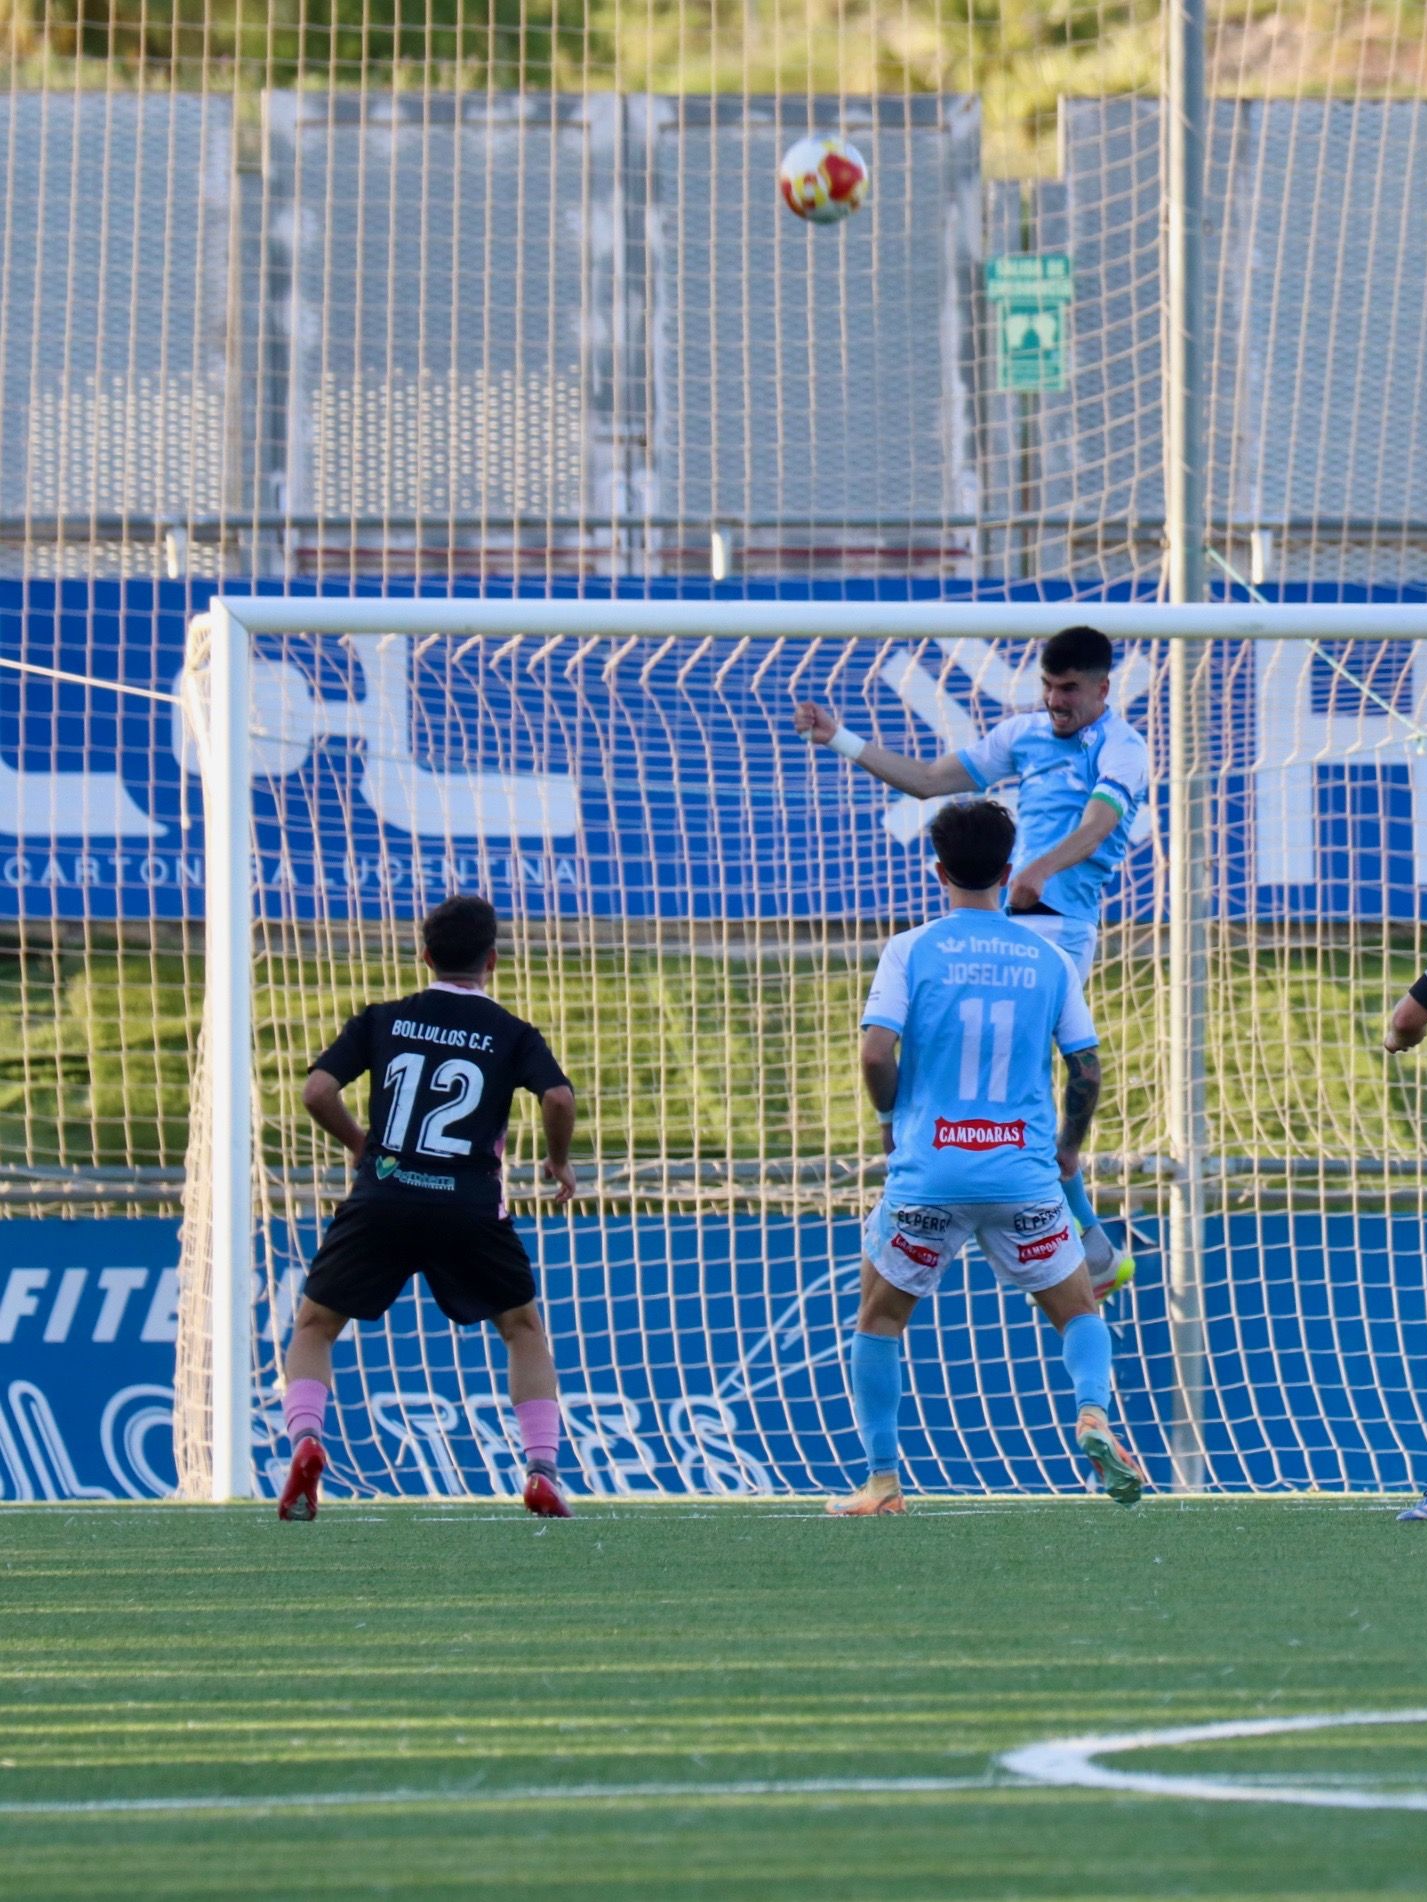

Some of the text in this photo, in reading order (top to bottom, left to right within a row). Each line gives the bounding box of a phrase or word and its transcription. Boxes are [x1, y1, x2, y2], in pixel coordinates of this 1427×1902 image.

[391, 1019, 494, 1053] BOLLULLOS C.F.
[958, 998, 1015, 1102] 11
[381, 1052, 485, 1158] 12
[939, 1126, 1020, 1143] CAMPOARAS
[1014, 1217, 1031, 1231] EL
